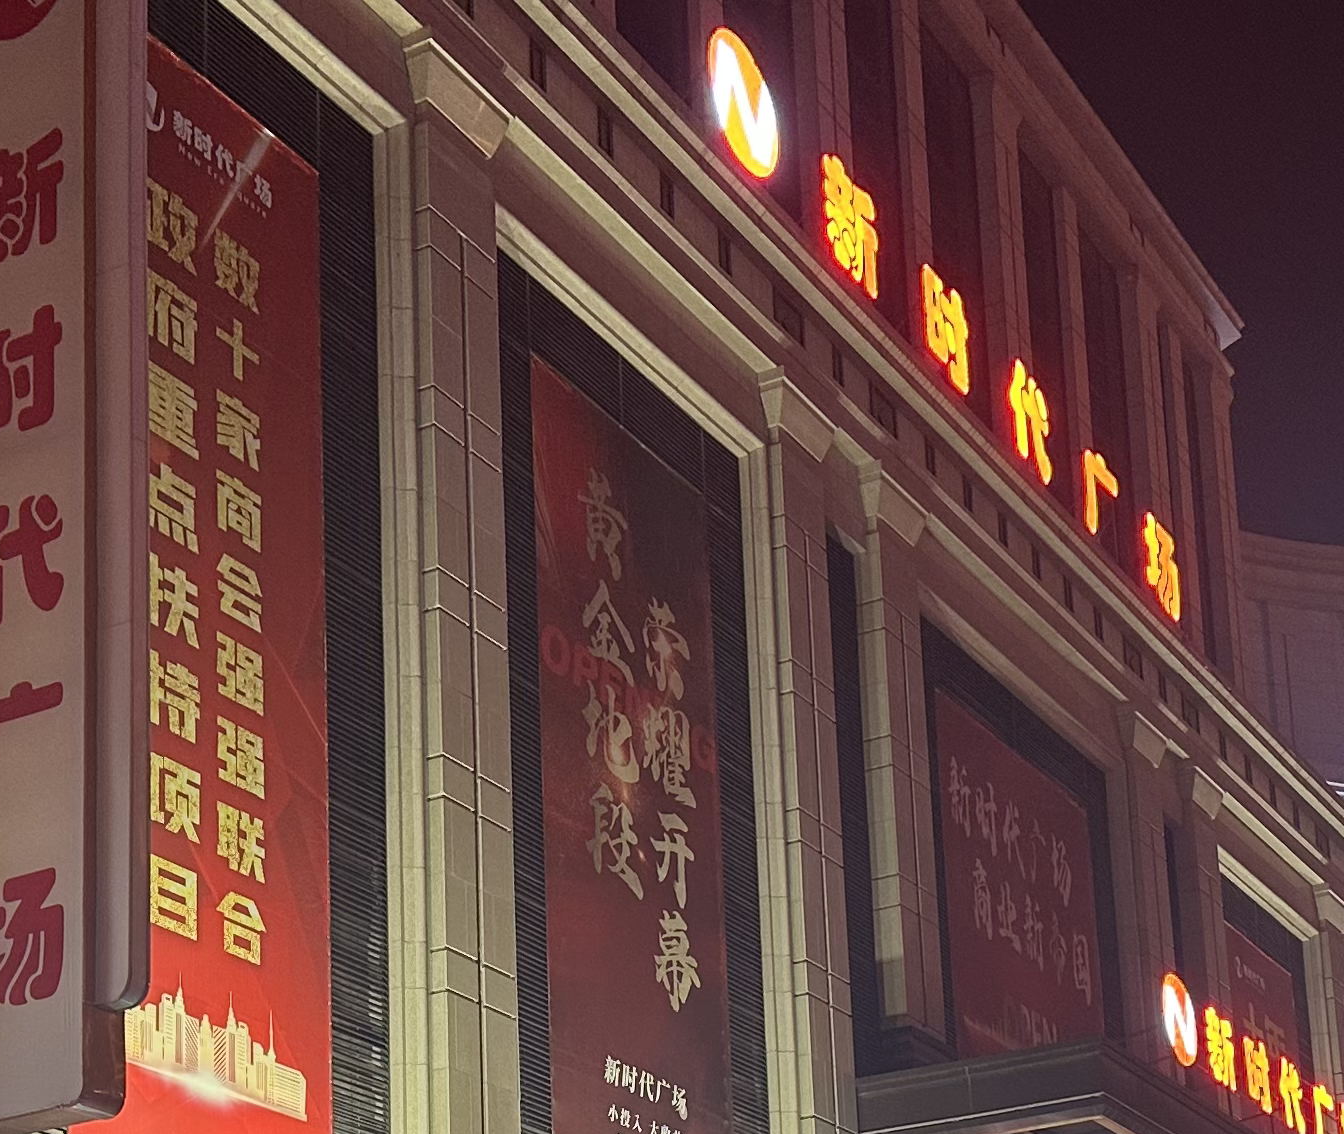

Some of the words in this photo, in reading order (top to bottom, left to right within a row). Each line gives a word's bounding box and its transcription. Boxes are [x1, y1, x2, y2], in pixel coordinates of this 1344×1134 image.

[173, 110, 272, 208] 新时代广场
[147, 177, 201, 941] 政府重点扶持项目
[822, 153, 1181, 622] 新时代广场
[214, 227, 267, 966] 数十家商会强强联合
[642, 597, 701, 1012] 荣耀开幕
[604, 1055, 687, 1120] 新时代广场
[608, 1104, 642, 1132] 小投入
